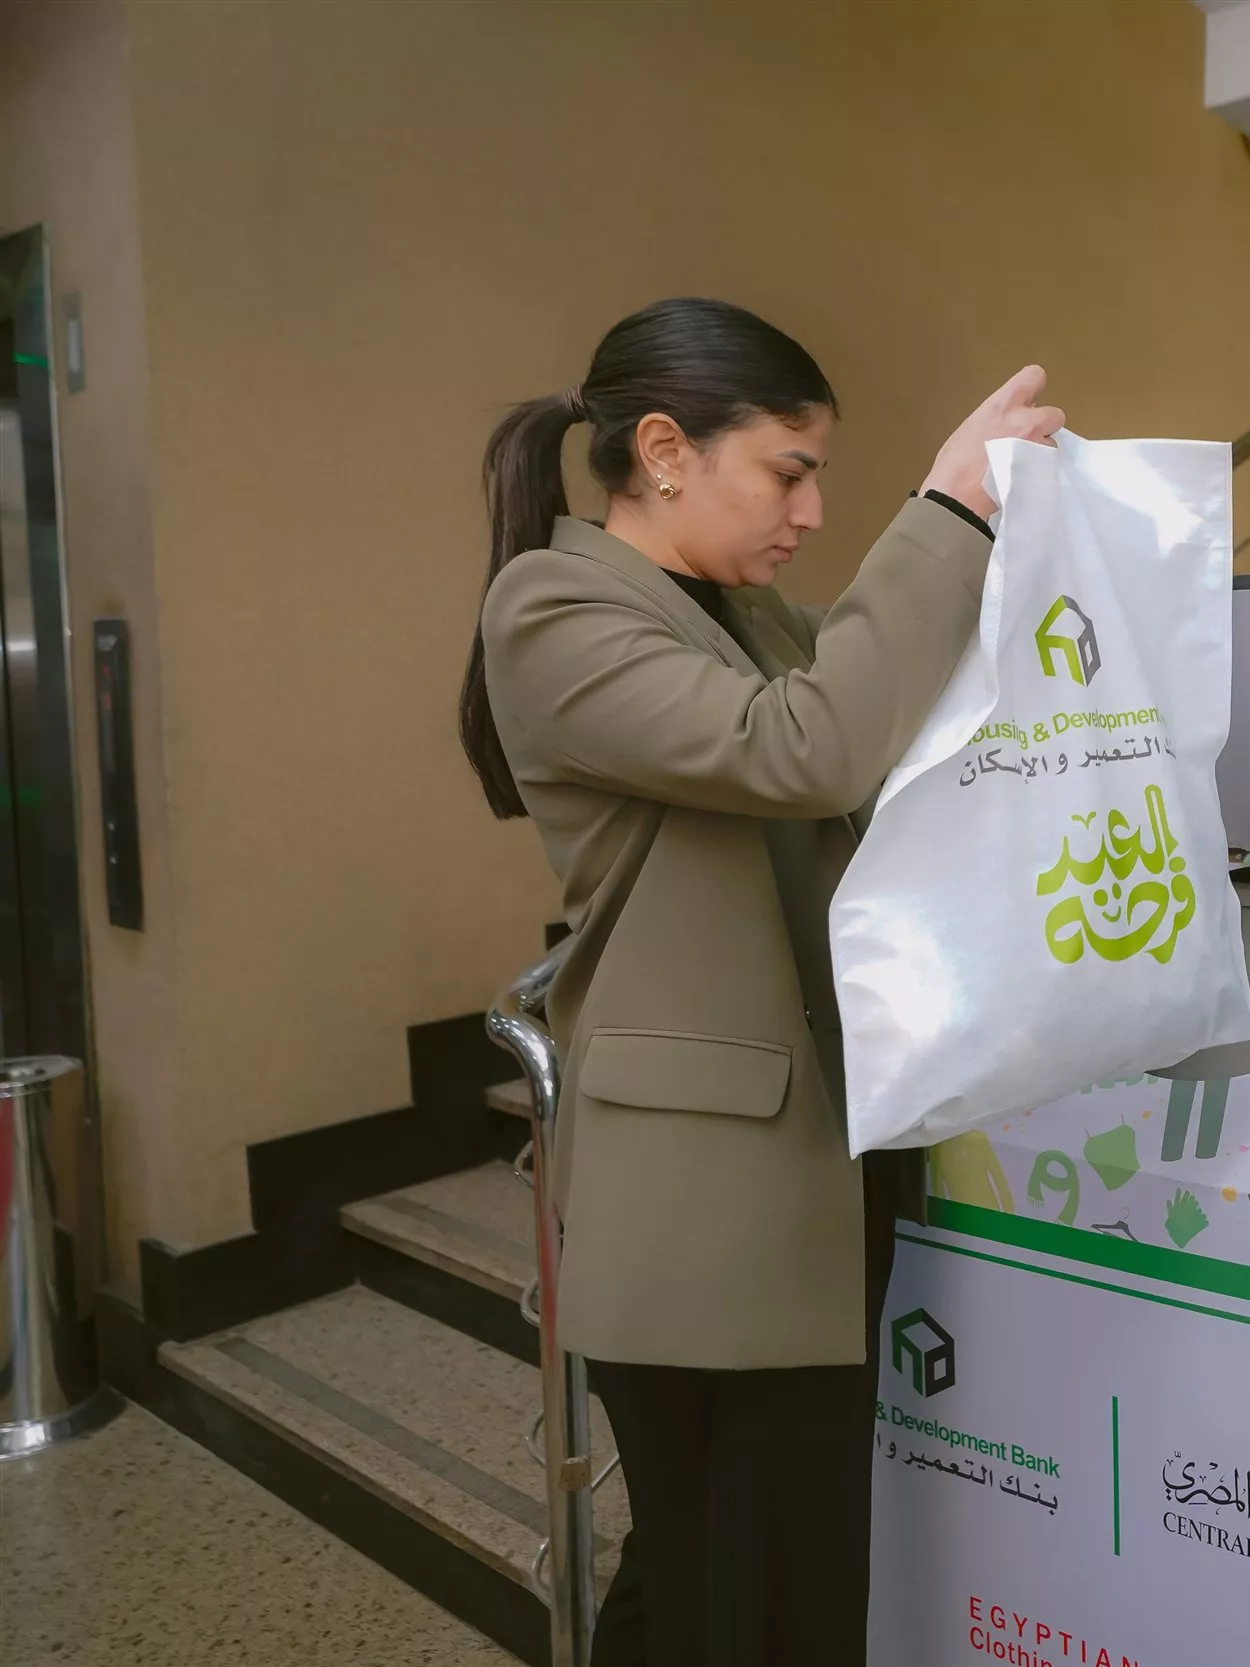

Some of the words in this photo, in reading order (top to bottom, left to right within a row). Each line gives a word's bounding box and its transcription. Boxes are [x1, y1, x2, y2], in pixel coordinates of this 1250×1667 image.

[1033, 722, 1050, 743] &
[1051, 706, 1163, 733] Developmen
[1055, 752, 1069, 775] و
[1077, 735, 1161, 768] التعمير
[1035, 783, 1179, 897] العيد
[875, 1401, 888, 1421] &
[891, 1405, 1008, 1461] Development
[1011, 1443, 1061, 1479] Bank
[884, 1441, 897, 1459] و
[902, 1451, 994, 1488] التعمير
[999, 1475, 1058, 1515] بنك
